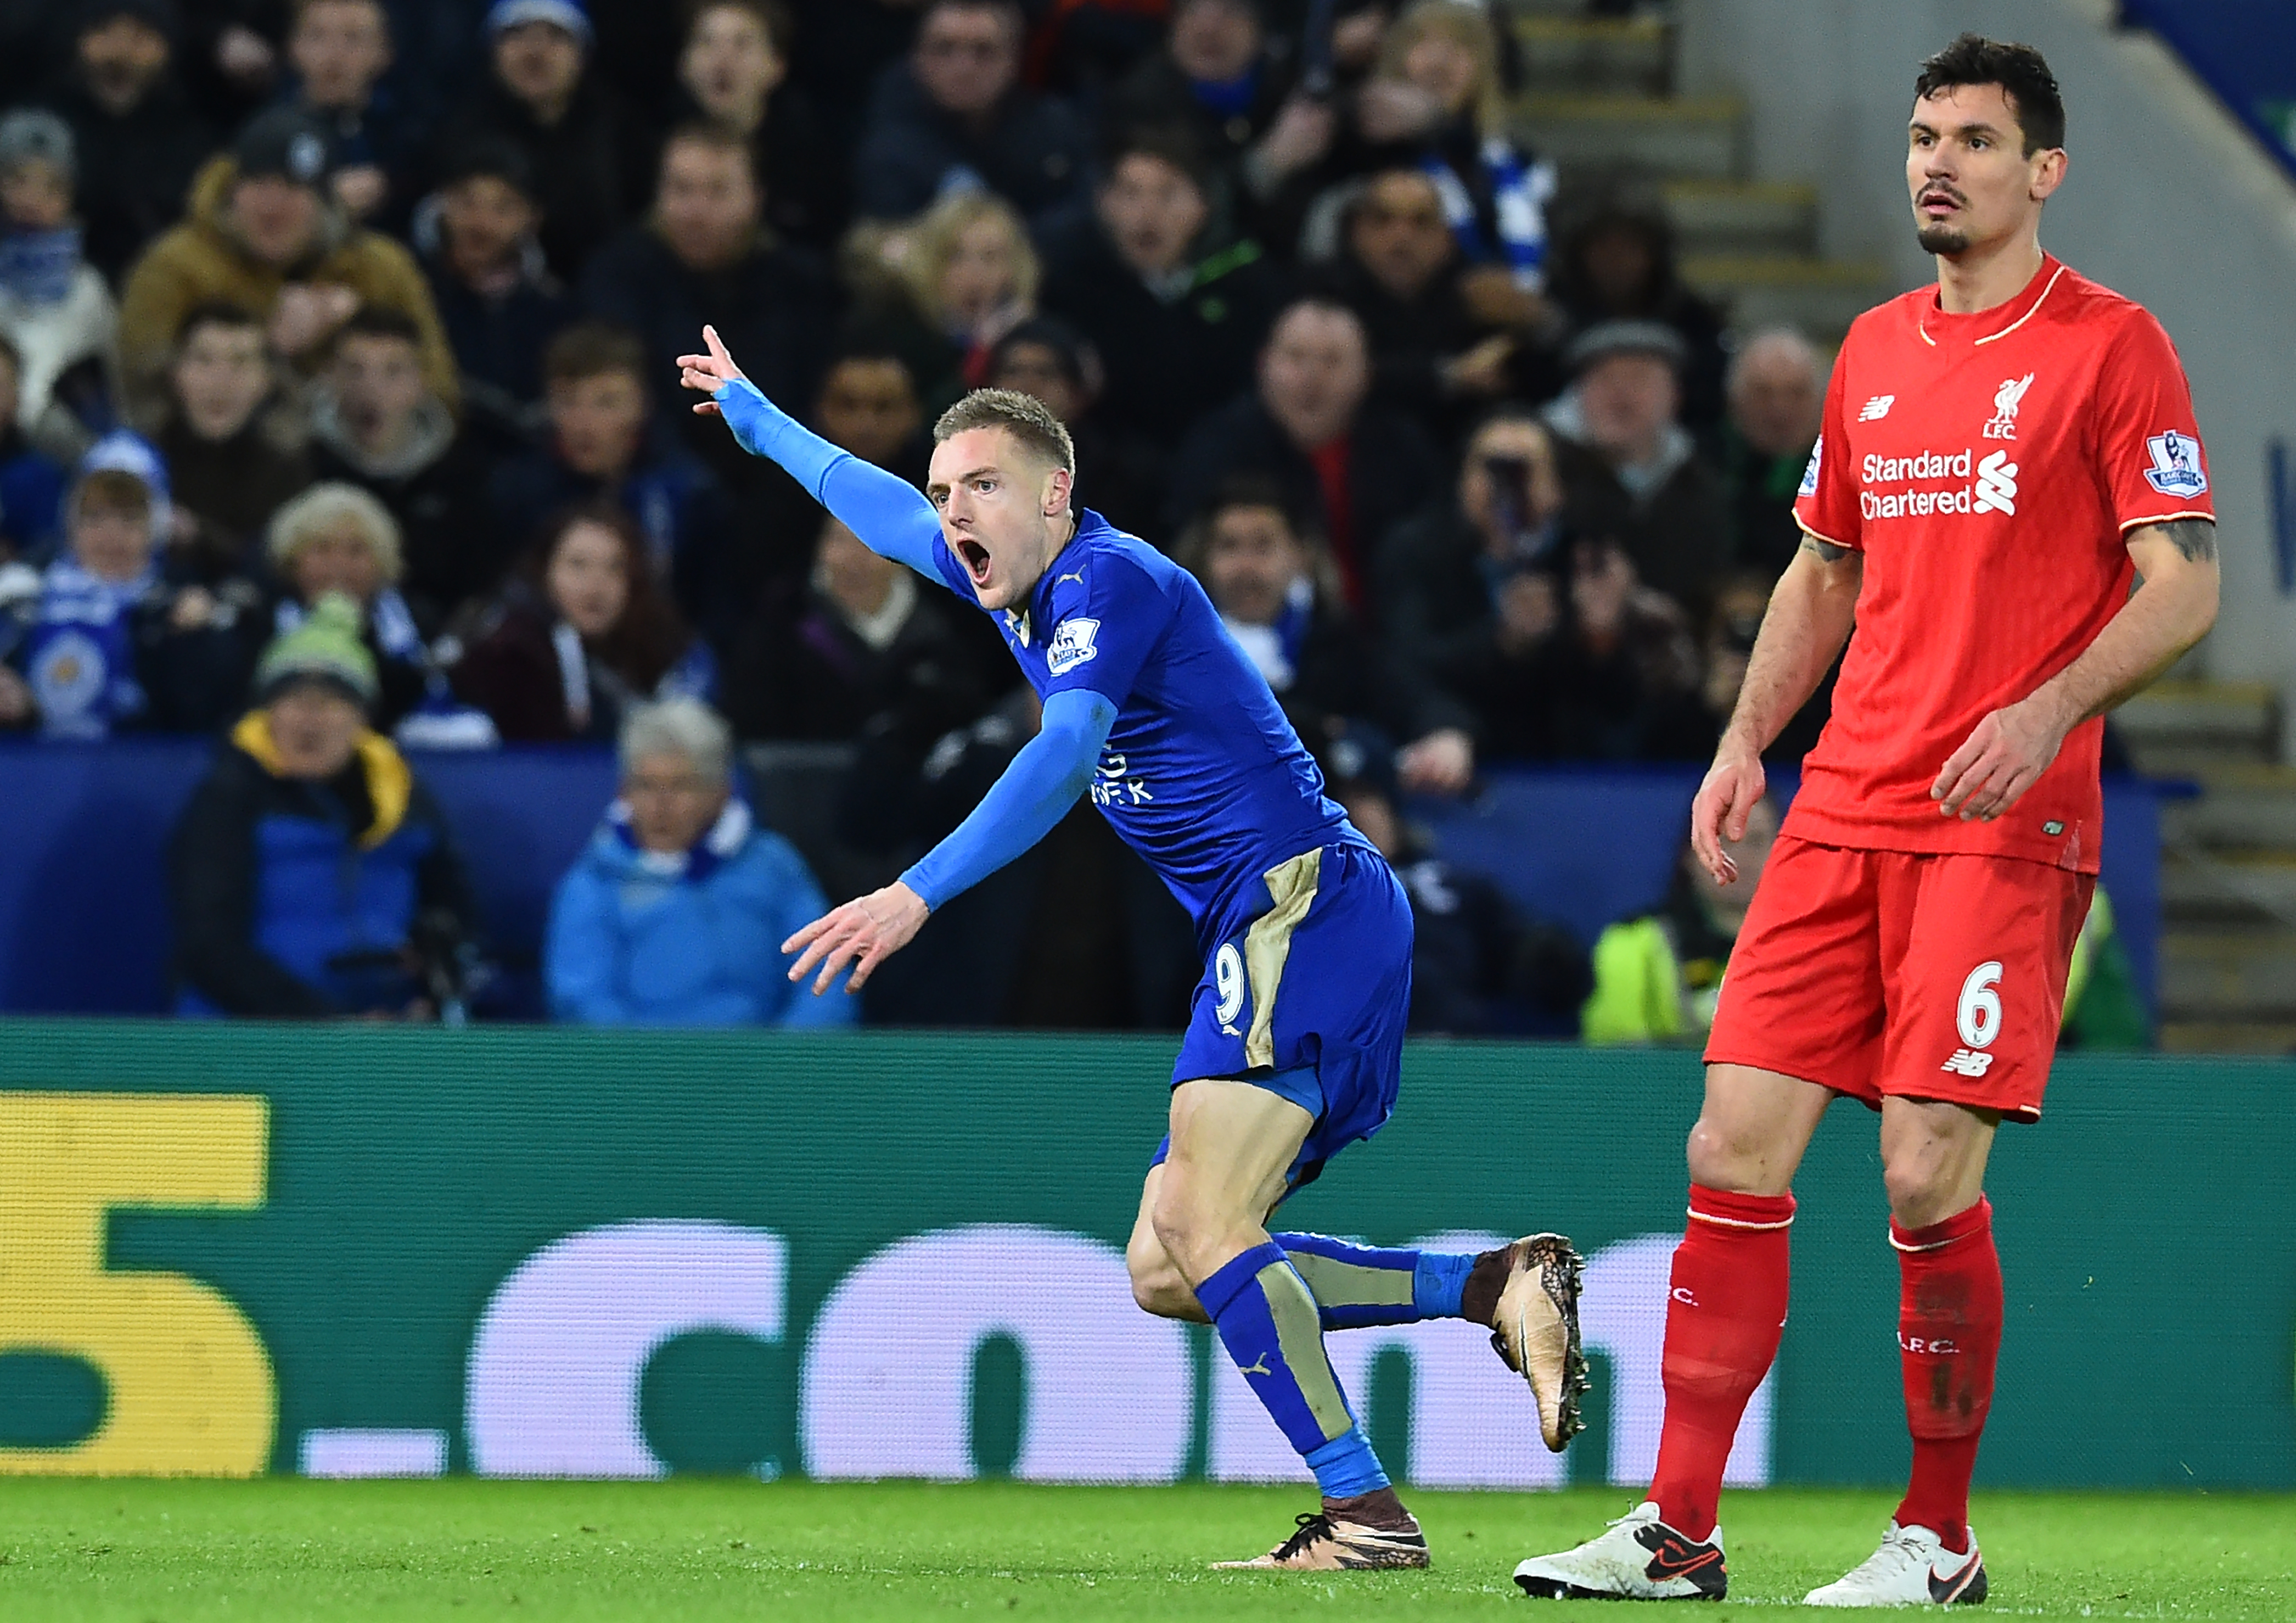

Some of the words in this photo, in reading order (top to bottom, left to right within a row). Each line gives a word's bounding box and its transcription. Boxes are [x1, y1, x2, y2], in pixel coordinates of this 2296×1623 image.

[1862, 447, 1971, 484] Standard
[1860, 484, 1971, 520] Chartered
[1215, 943, 1244, 1025] 9
[1957, 961, 2002, 1049] 6
